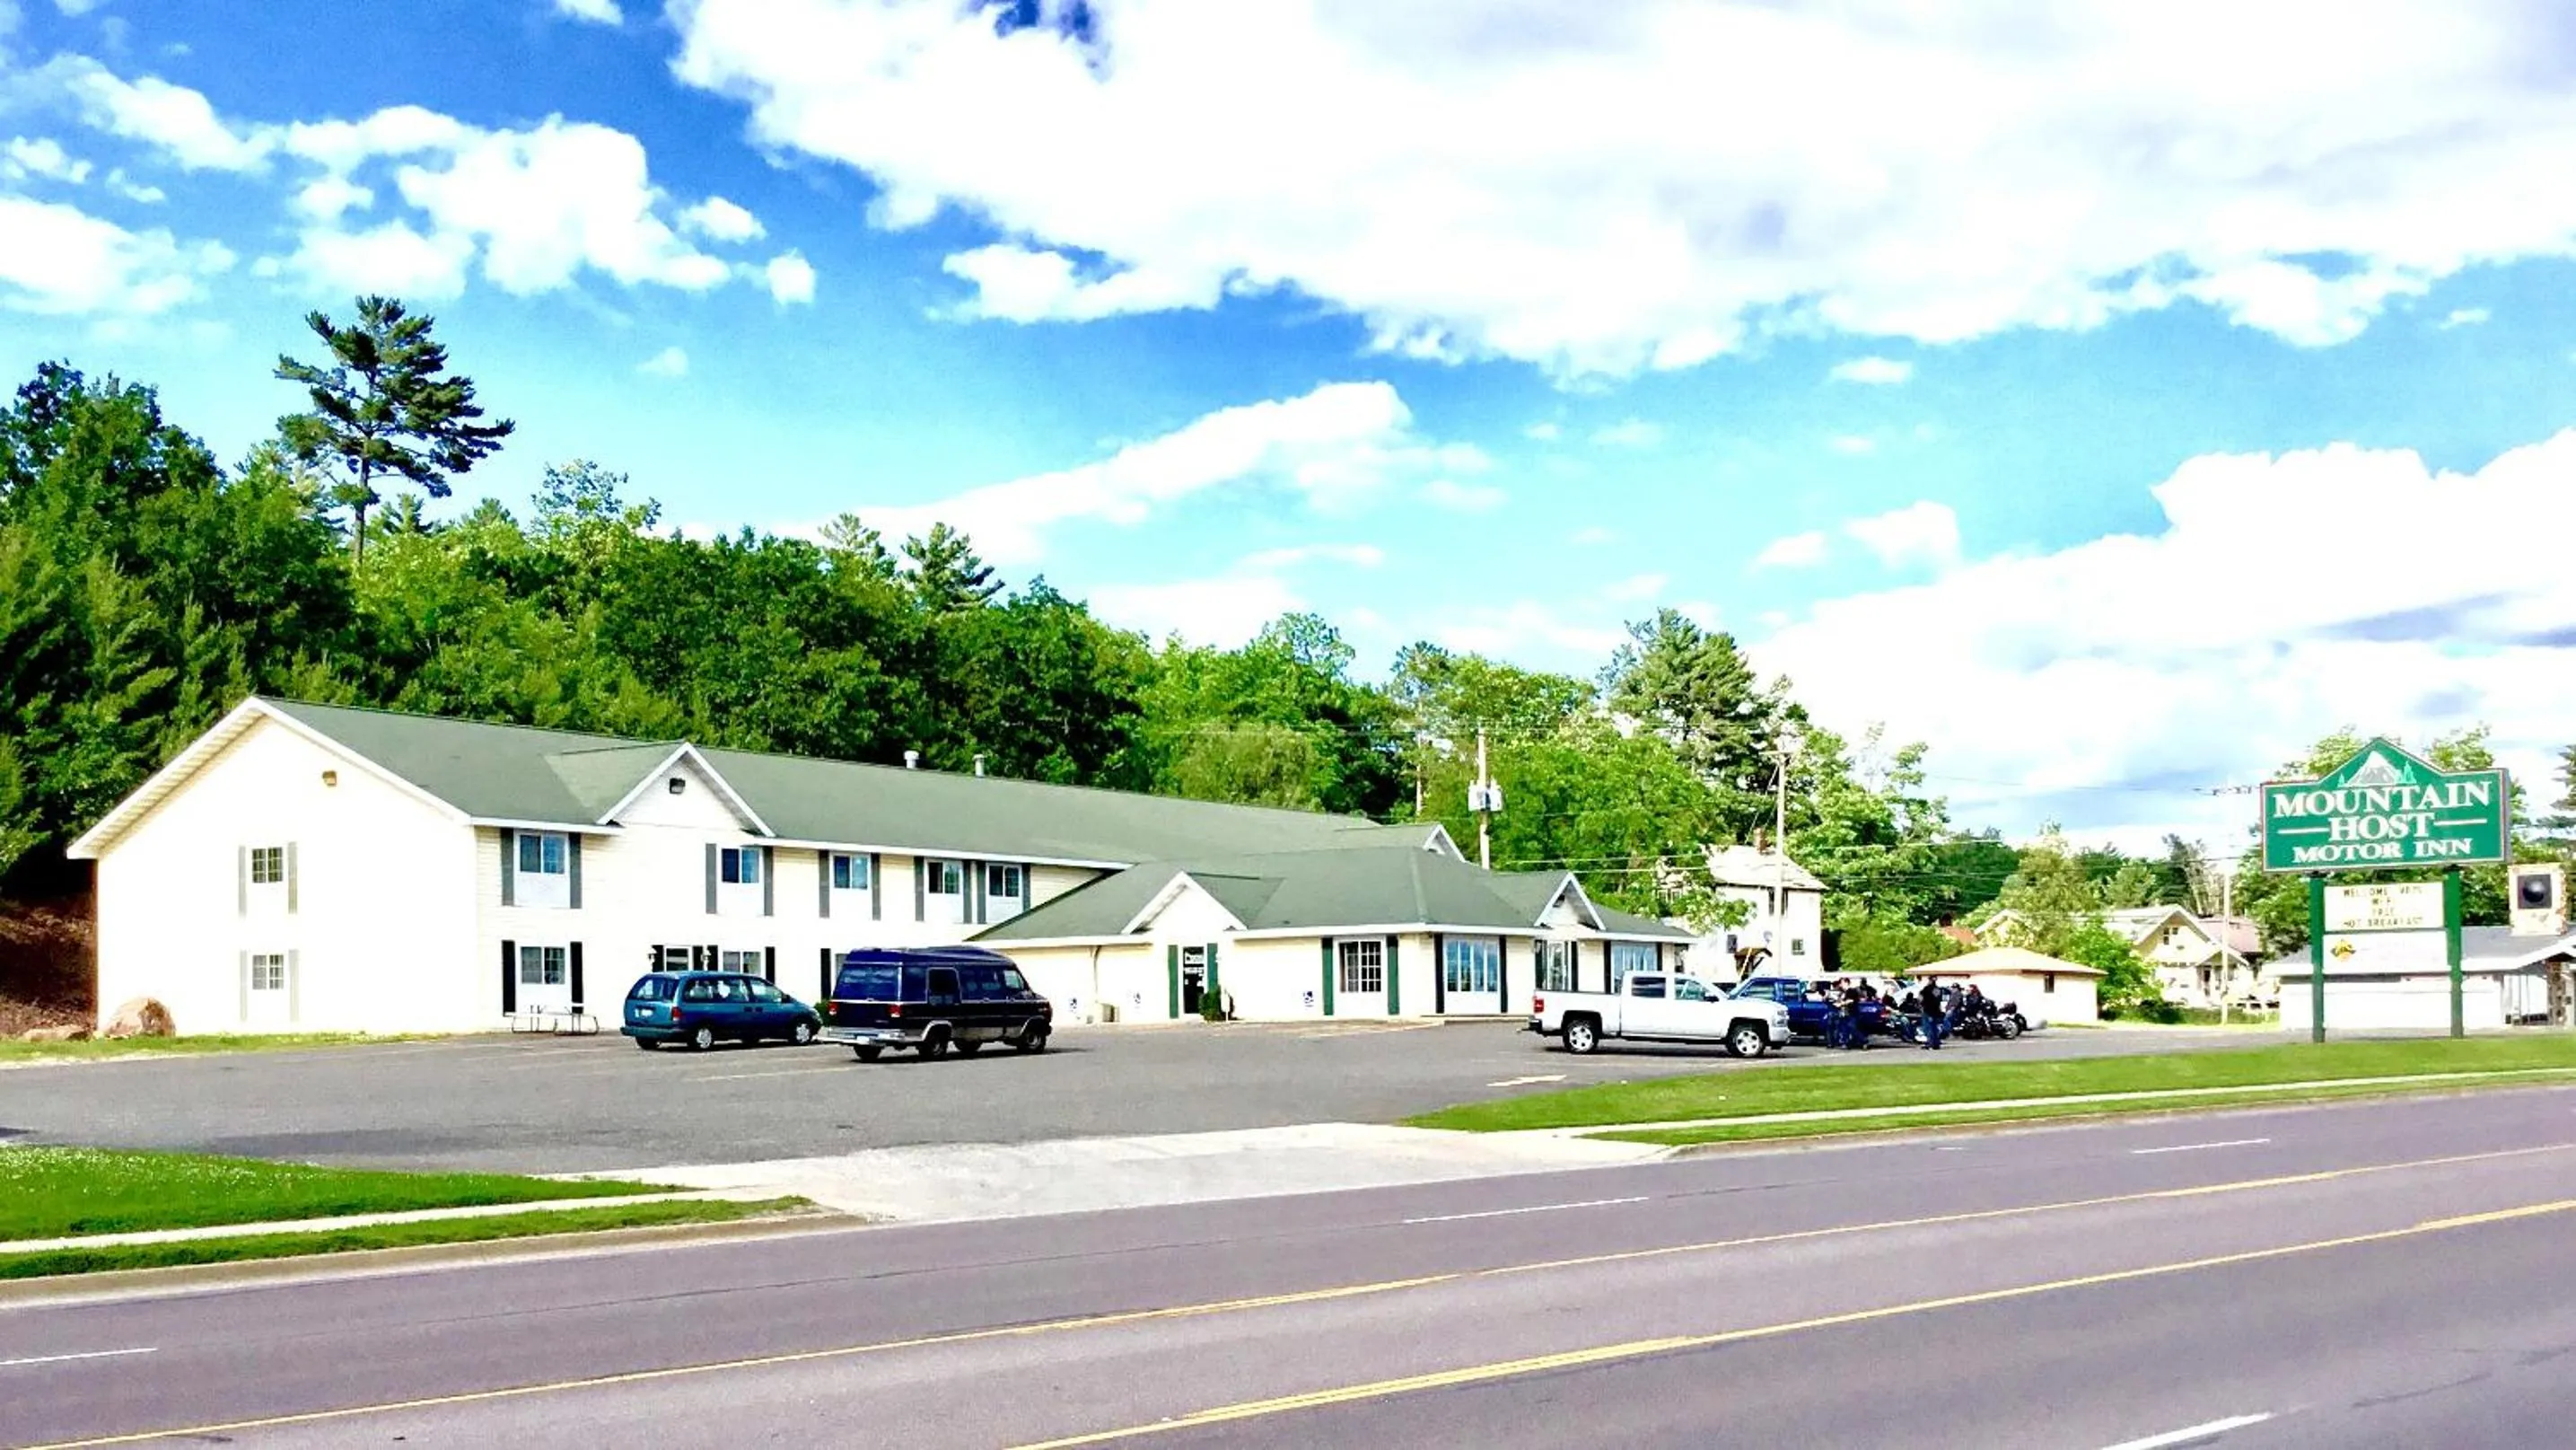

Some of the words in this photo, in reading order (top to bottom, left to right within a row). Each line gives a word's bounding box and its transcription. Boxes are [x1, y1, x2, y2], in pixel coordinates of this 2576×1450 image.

[2274, 780, 2492, 818] MOUNTAIN
[2328, 812, 2435, 841] HOST
[2292, 842, 2403, 864] MOTOR
[2414, 838, 2473, 857] INN
[2344, 887, 2388, 897] WELOME
